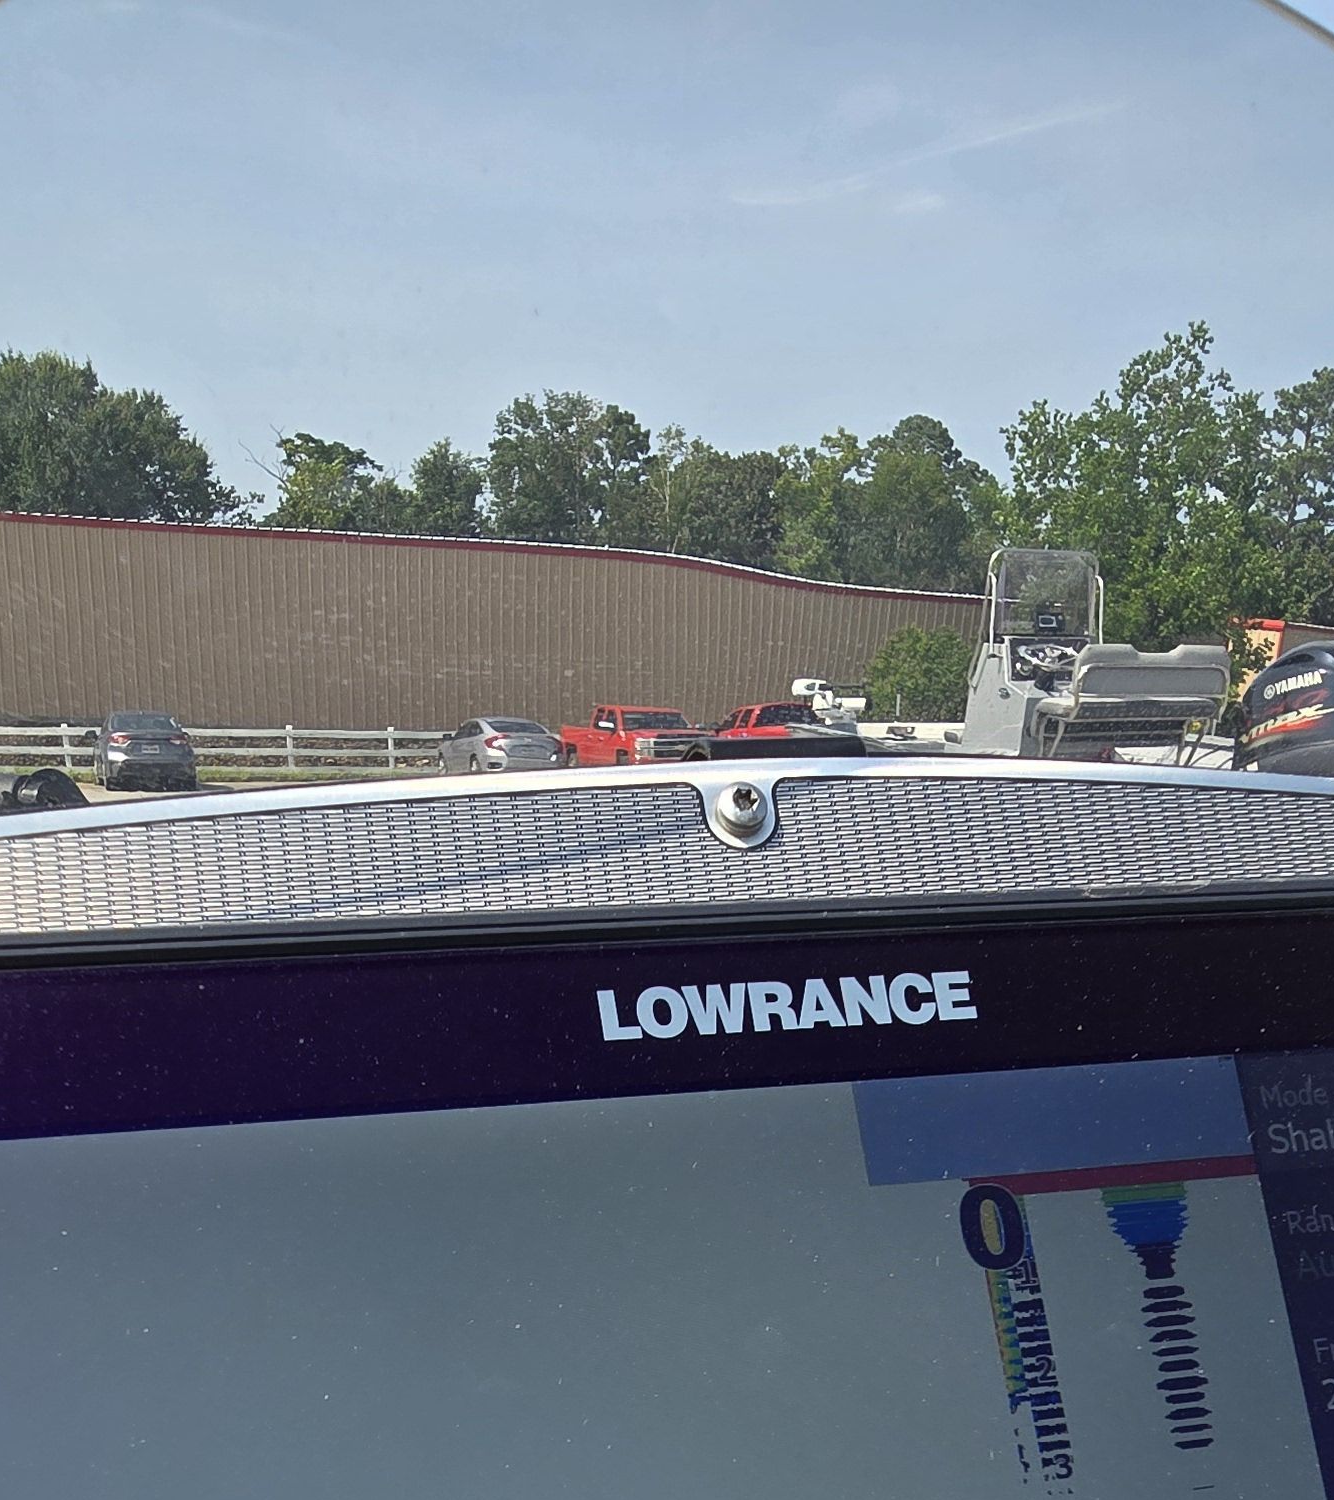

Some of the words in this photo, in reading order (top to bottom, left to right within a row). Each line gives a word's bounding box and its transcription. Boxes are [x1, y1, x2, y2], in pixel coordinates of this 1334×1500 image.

[1274, 669, 1327, 694] YAMAHA
[596, 971, 978, 1041] LOWRANCE
[1260, 1075, 1328, 1108] Mode
[959, 1184, 1026, 1271] 0
